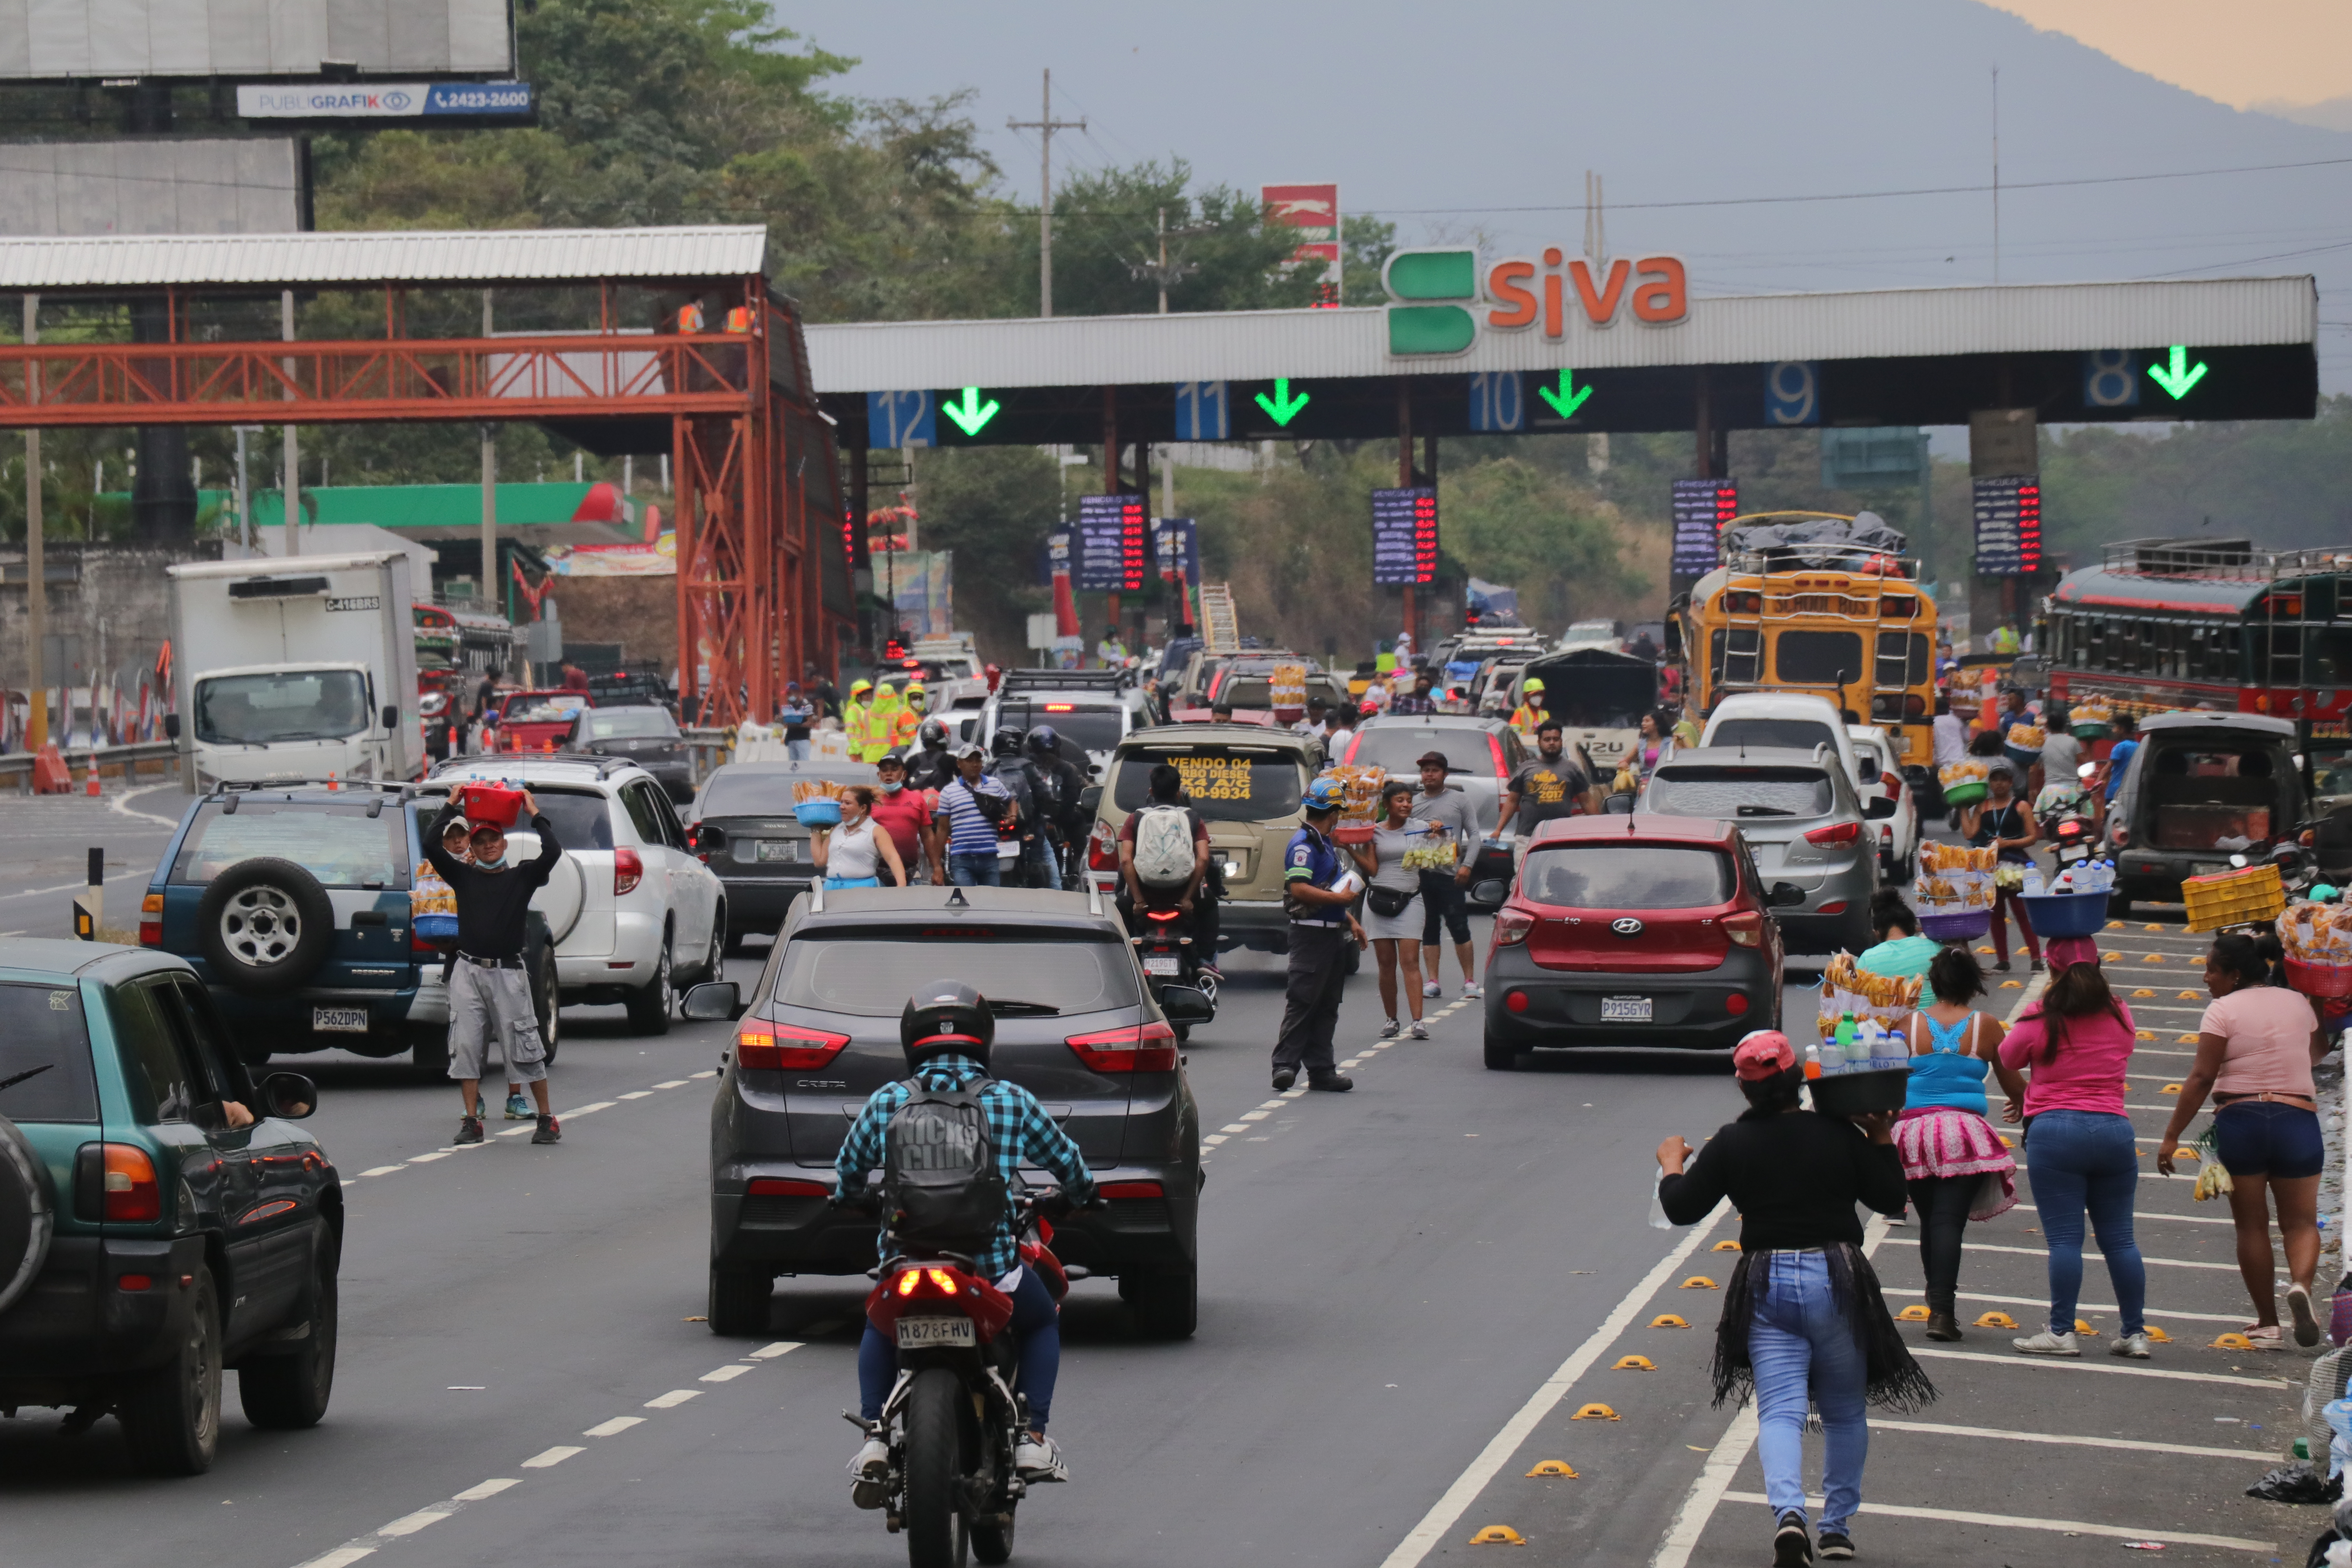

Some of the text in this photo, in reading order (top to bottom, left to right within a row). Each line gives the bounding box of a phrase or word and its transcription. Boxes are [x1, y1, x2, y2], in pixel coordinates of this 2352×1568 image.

[259, 92, 528, 110] PUBLIGRAFIK 2423-2600
[1488, 247, 1687, 337] siva
[2089, 350, 2134, 407] 8
[1472, 370, 1522, 431] 10
[1769, 361, 1813, 425] 9
[1176, 381, 1227, 440] 11
[878, 391, 929, 448] 12
[1838, 594, 1869, 615] BUS
[1167, 757, 1252, 770] VENDO 04
[1209, 769, 1251, 779] DIESEL
[1180, 778, 1251, 788] X4 A/C
[1539, 790, 1564, 799] 2017
[1145, 959, 1177, 967] M219GTY
[1602, 1002, 1651, 1016] P915GYR
[315, 1011, 365, 1026] P562DPN
[797, 1080, 846, 1088] CRETA
